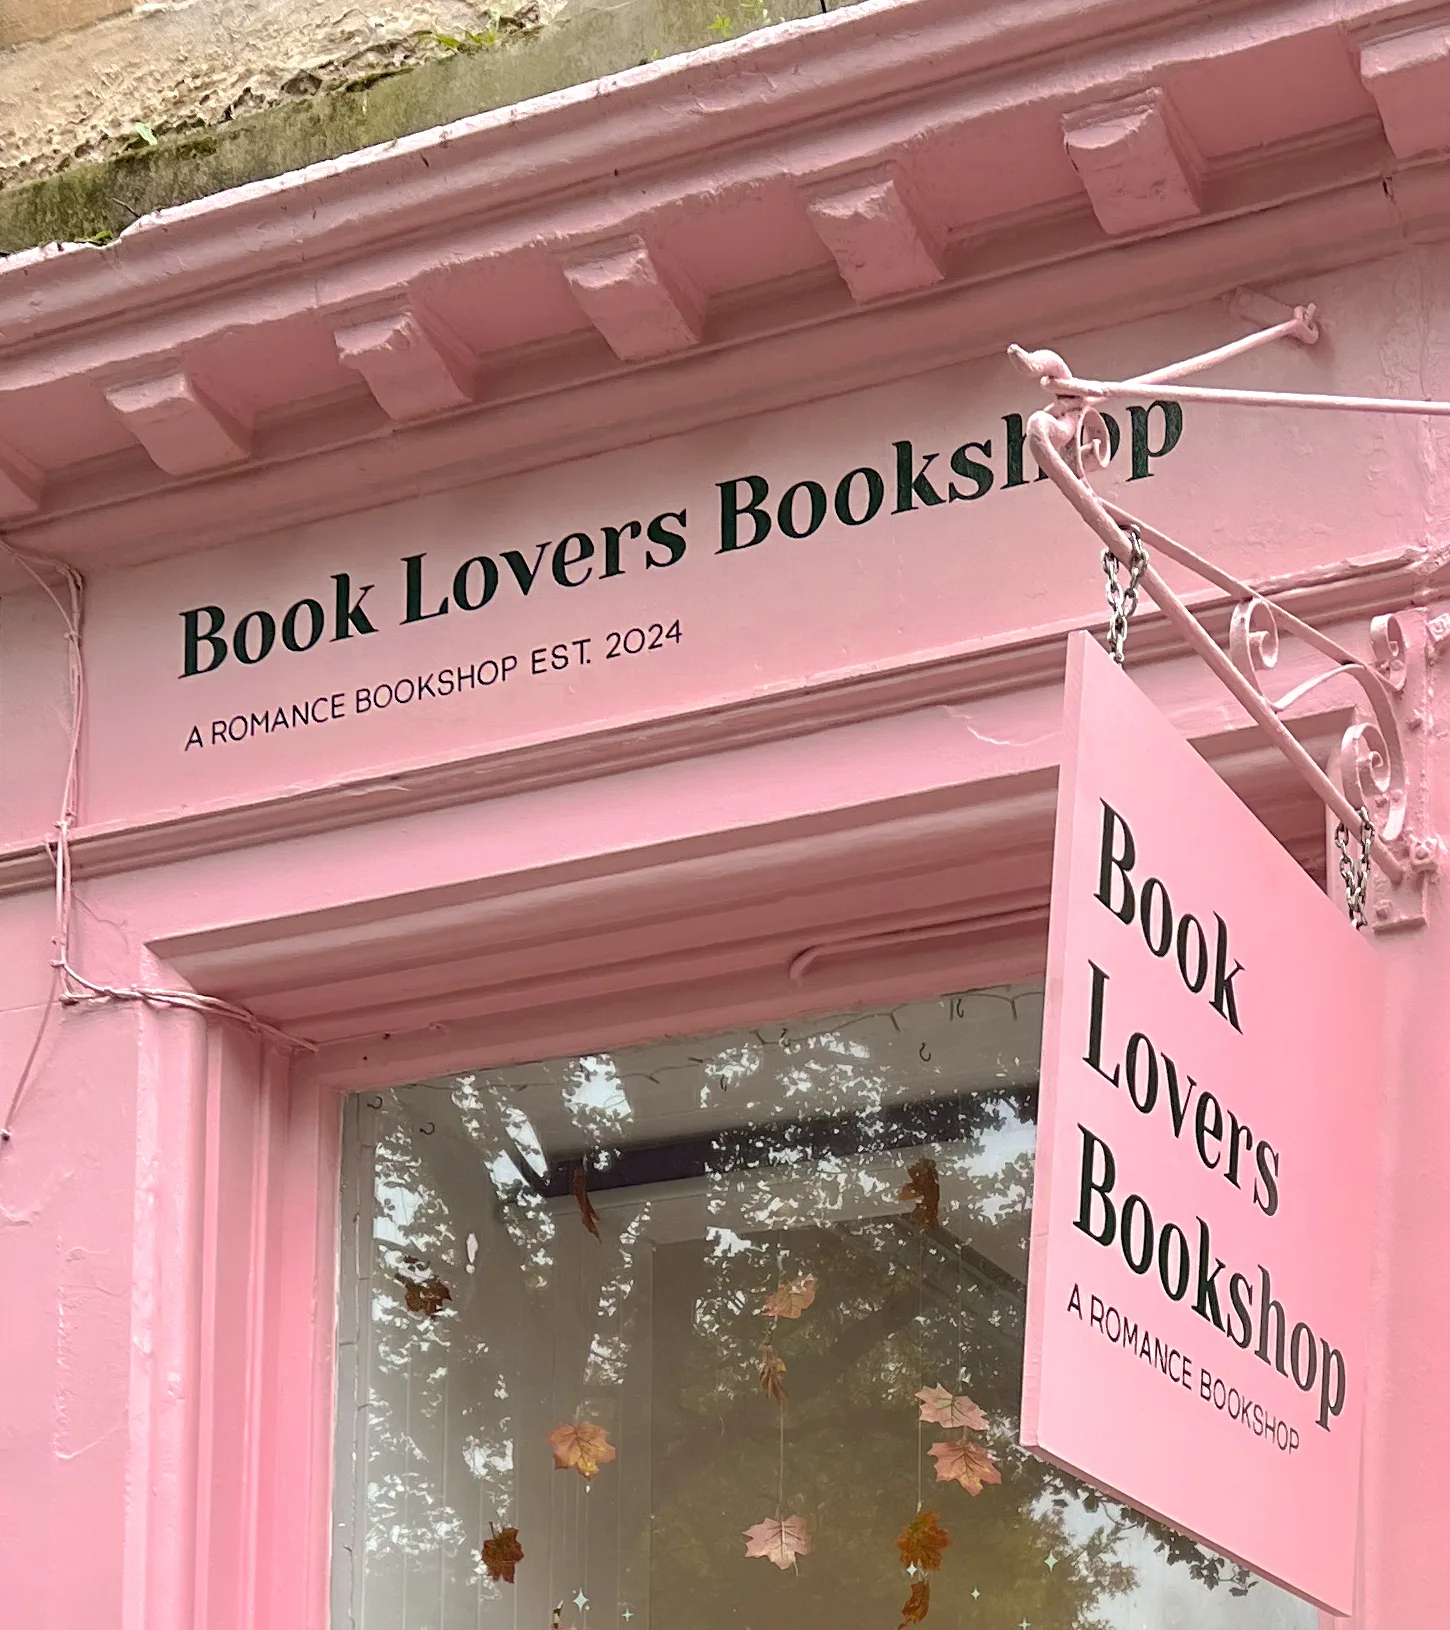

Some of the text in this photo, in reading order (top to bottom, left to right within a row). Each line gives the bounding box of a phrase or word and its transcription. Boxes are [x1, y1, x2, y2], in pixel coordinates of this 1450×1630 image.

[178, 573, 379, 679] Book
[400, 508, 688, 625] Lovers
[185, 619, 683, 751] A ROMANCE BOOKSHOP EST. 2024
[1093, 796, 1245, 1035] Book
[1082, 958, 1279, 1216] Lovers
[1066, 1283, 1301, 1455] A ROMANCE BOOKSHOP
[1072, 1122, 1346, 1432] Bookshop
